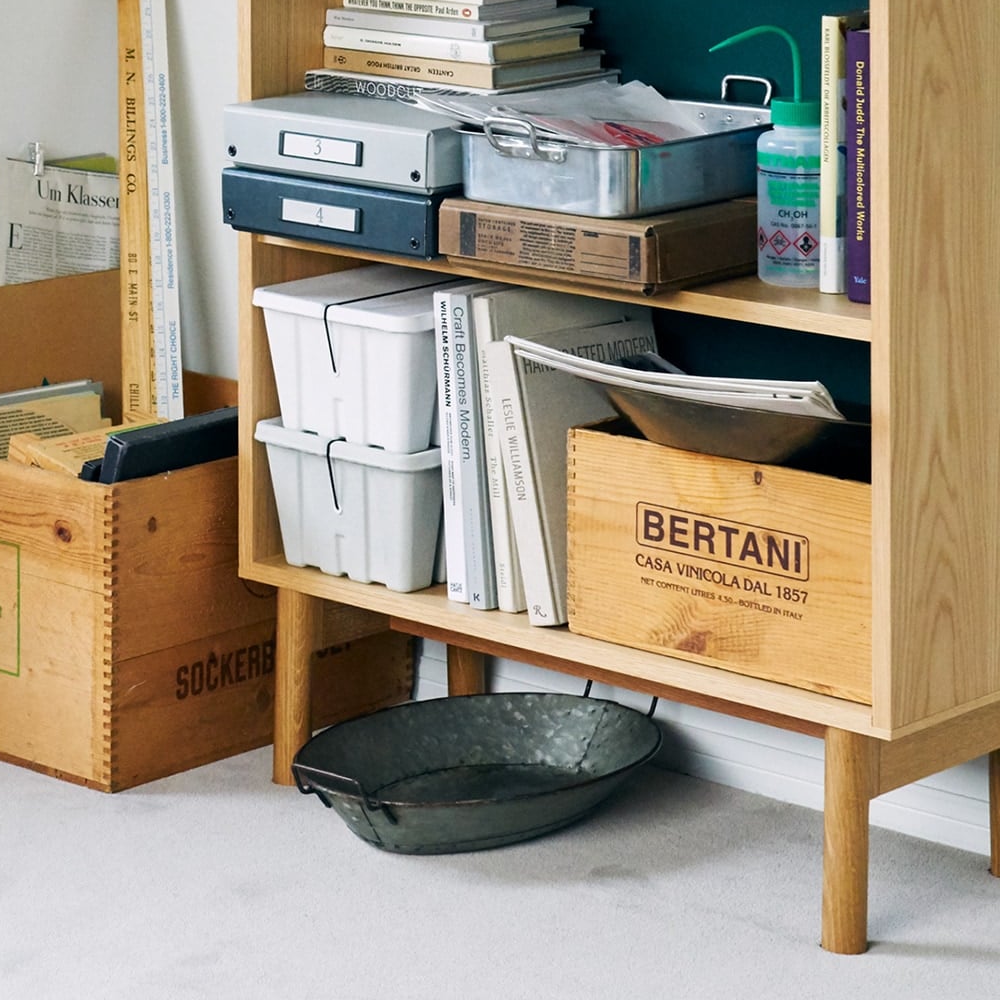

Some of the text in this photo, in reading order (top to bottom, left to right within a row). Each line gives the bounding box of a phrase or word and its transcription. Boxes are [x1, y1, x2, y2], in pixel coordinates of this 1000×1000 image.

[370, 0, 378, 8] YOU
[392, 2, 405, 11] THINK
[414, 4, 434, 14] OPPOSITE
[435, 6, 445, 14] Paul
[446, 7, 459, 16] Arden
[366, 60, 453, 78] CANTEEN GREAT BRITISH FOOD
[125, 48, 137, 195] M. N. BILLINGS CO.
[160, 129, 169, 165] Business
[313, 139, 322, 155] 3
[856, 61, 866, 242] Donald Judd: The Multicolored Works
[37, 179, 61, 202] Um
[315, 207, 324, 223] 4
[9, 223, 23, 249] E
[165, 249, 174, 289] Residence
[854, 275, 868, 285] Yale
[128, 283, 138, 306] MAIN
[129, 311, 138, 323] ST
[440, 301, 449, 344] WILHELM
[168, 320, 177, 353] CHOICE
[608, 336, 655, 360] MODERN
[170, 355, 178, 381] RIGHT
[442, 346, 452, 407] SCHÜRMANN
[453, 307, 473, 464] Craft Becomes Modern.
[502, 398, 527, 501] LESLIE WILLIAMSON
[635, 553, 808, 604] CASA VINICOLA DAL 1857
[473, 593, 481, 602] K
[641, 577, 655, 588] NET
[656, 580, 690, 595] CONTENT
[691, 588, 716, 600] LITRES
[738, 599, 772, 613] BOTTLED
[773, 607, 782, 615] IN
[783, 610, 803, 621] ITALY
